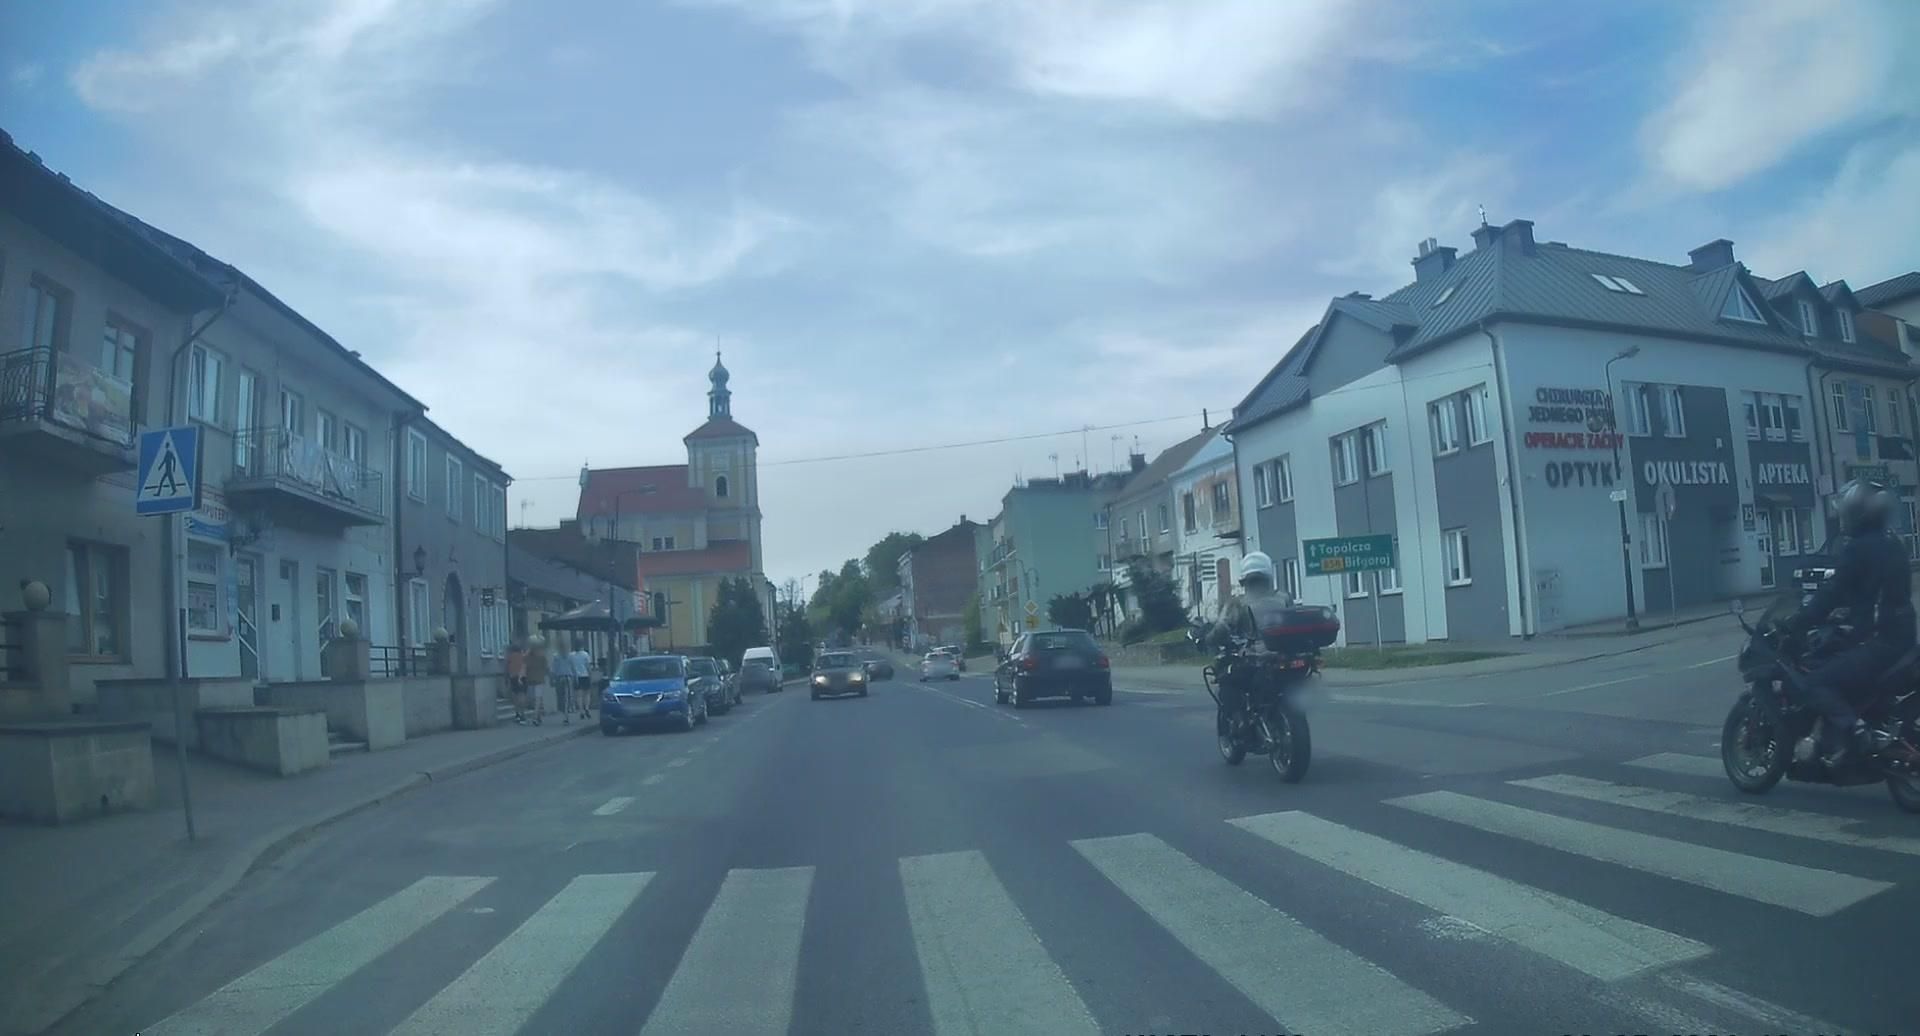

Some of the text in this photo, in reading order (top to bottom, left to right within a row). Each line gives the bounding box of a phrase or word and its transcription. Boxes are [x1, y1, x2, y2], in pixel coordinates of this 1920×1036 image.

[1528, 406, 1584, 423] JEDNEGO
[1525, 431, 1584, 449] OPERACJE
[1545, 461, 1614, 488] OPTYK
[1644, 460, 1730, 485] OKULISTA
[1758, 463, 1809, 484] APTEKA
[1318, 542, 1371, 556] Topólcza
[1344, 554, 1391, 569] Biłgoraj
